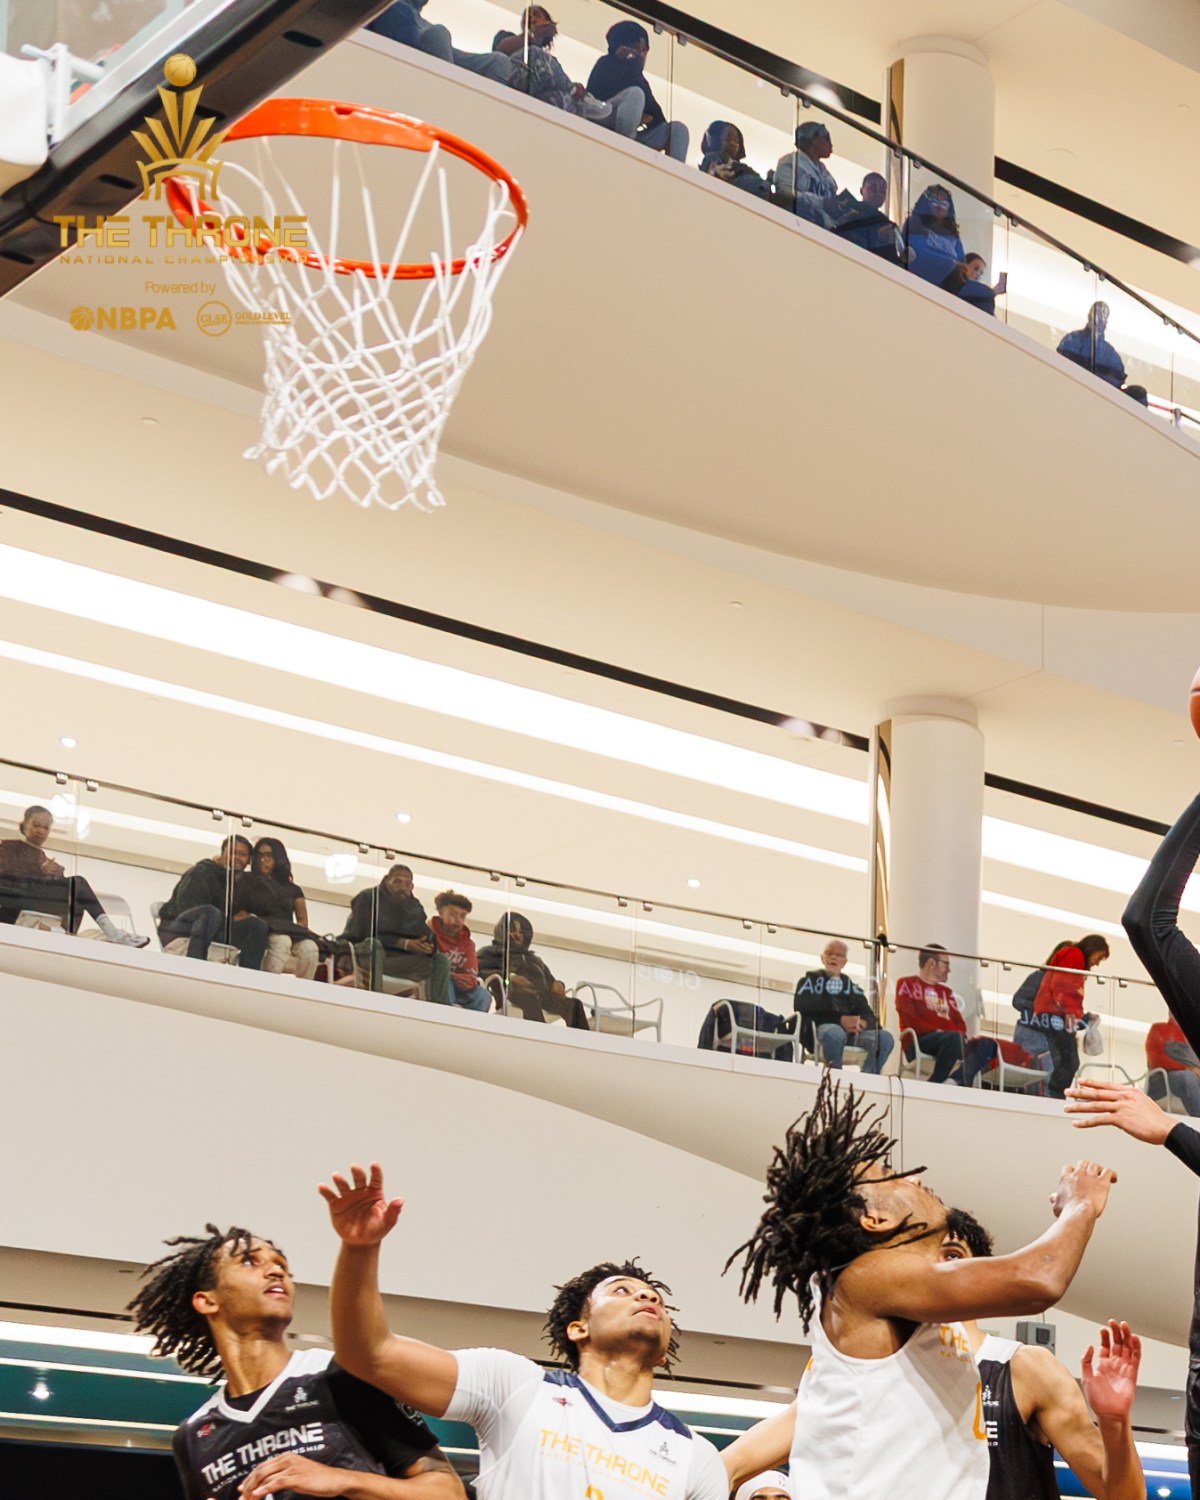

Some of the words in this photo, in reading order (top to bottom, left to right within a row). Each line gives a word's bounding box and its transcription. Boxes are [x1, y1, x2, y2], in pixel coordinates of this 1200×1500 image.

[201, 1452, 236, 1485] THE
[236, 1422, 324, 1465] THRONE
[540, 1429, 582, 1455] THE
[586, 1443, 670, 1497] THRONE
